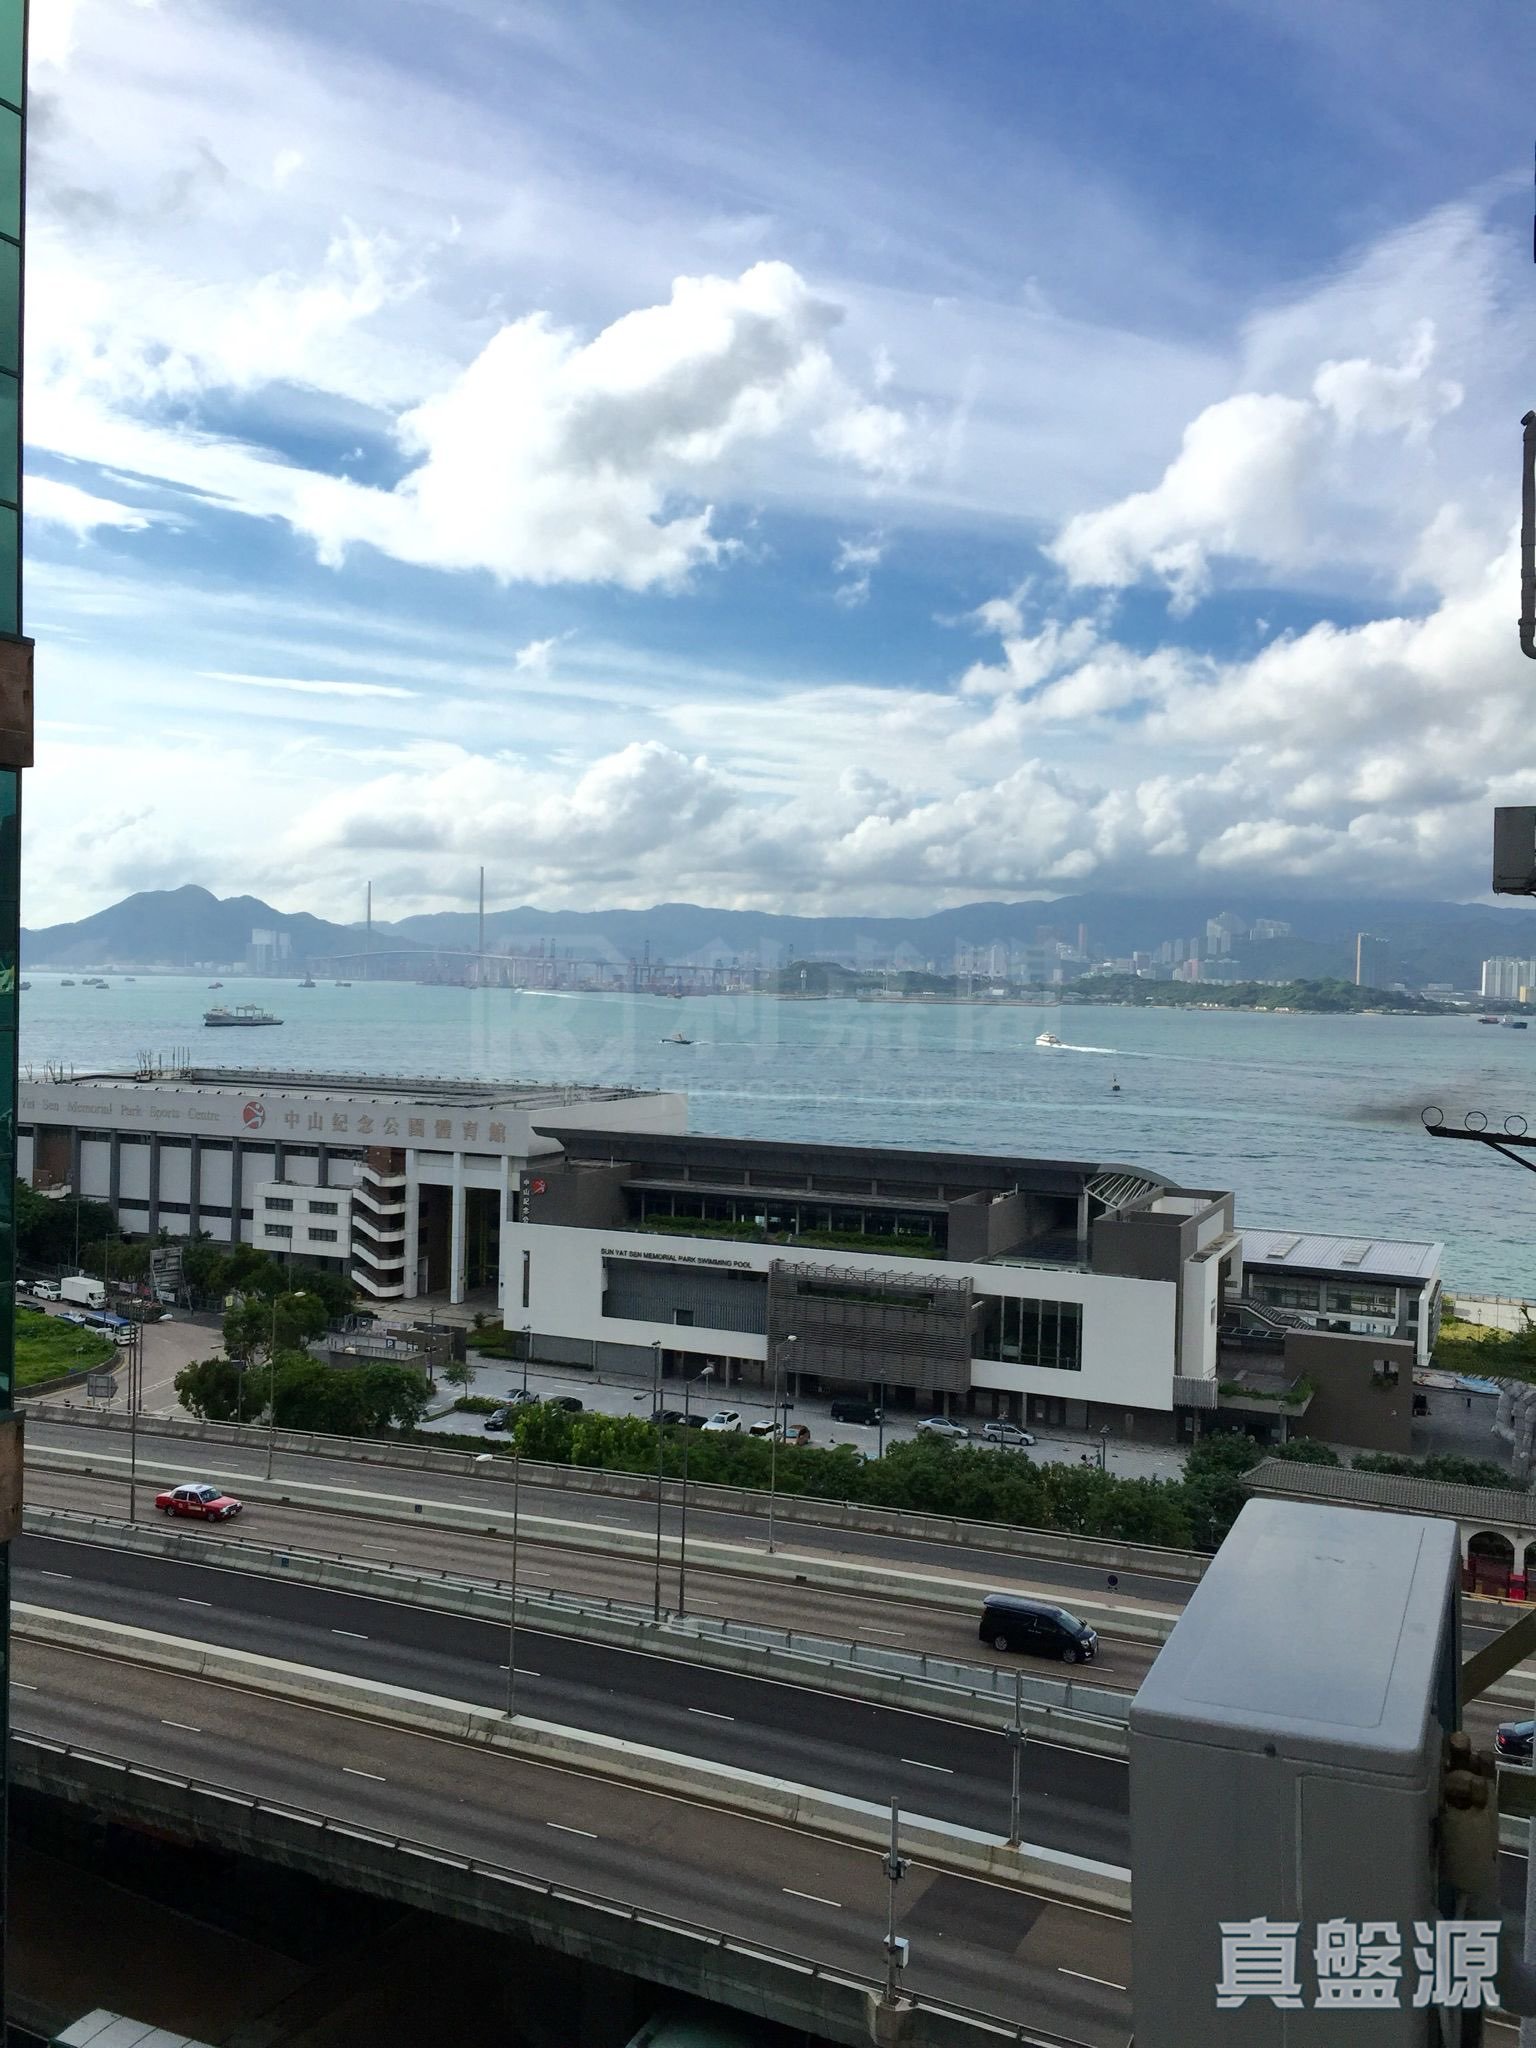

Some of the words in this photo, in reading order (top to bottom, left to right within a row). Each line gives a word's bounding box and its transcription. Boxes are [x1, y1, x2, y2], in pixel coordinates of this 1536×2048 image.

[42, 1100, 59, 1112] Sen
[67, 1101, 112, 1115] Memorial
[121, 1104, 142, 1116] Park
[150, 1105, 180, 1119] Sports
[188, 1107, 220, 1121] Centre
[629, 1250, 642, 1258] SEN
[643, 1252, 677, 1261] MEMORIAL
[678, 1255, 696, 1263] PARK
[697, 1257, 732, 1267] SWIMMING
[733, 1260, 752, 1269] POOL
